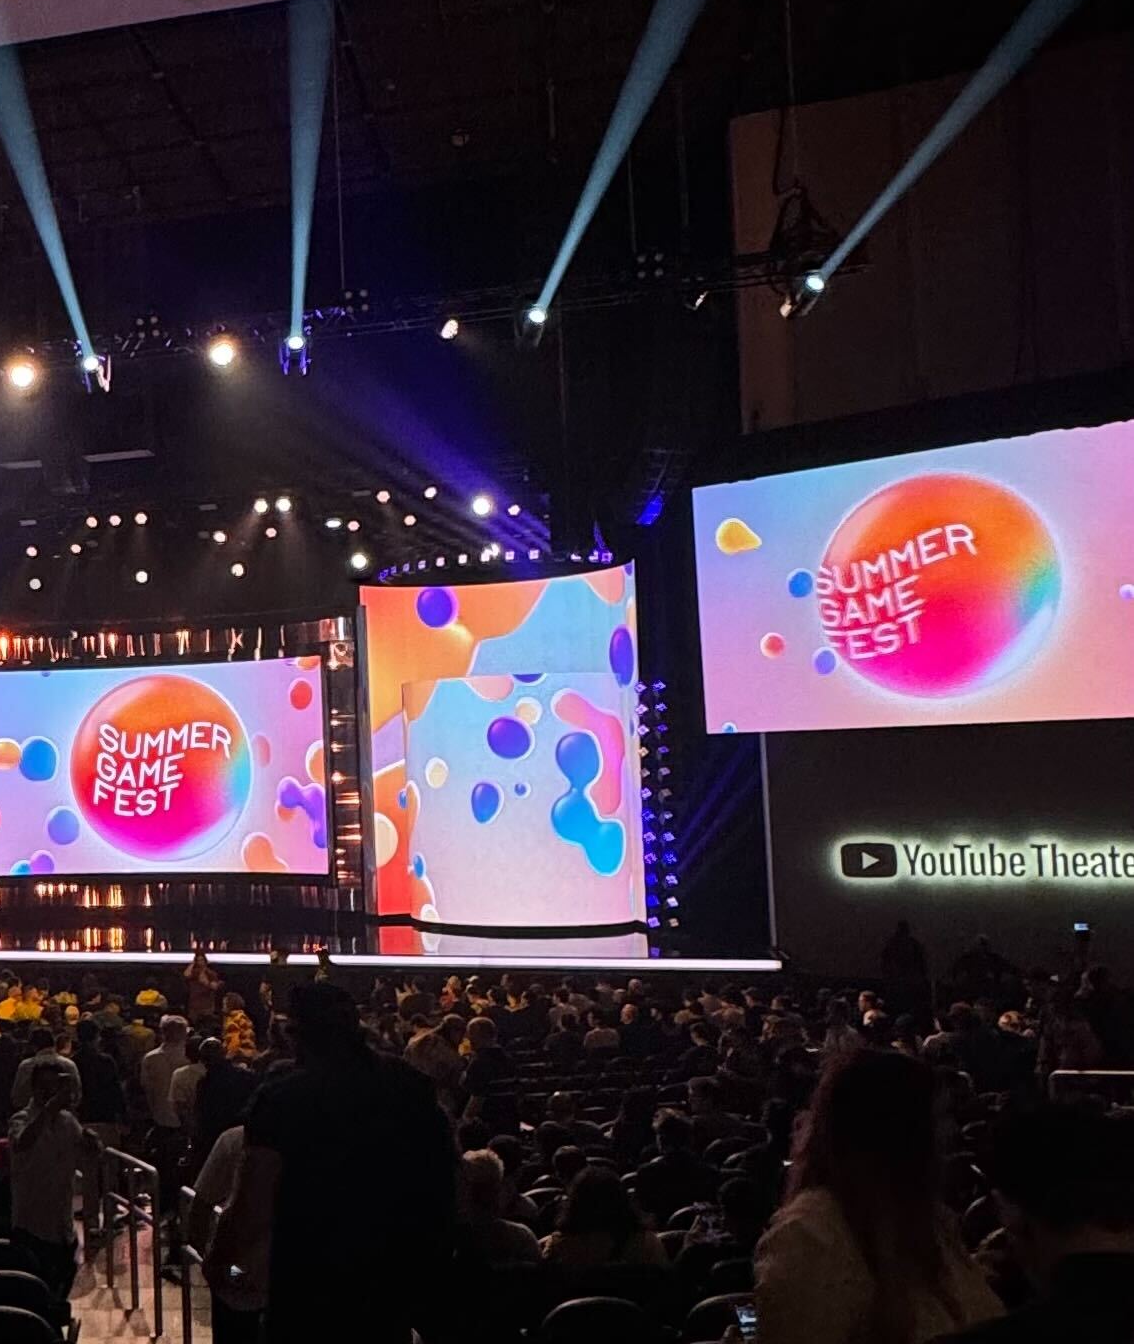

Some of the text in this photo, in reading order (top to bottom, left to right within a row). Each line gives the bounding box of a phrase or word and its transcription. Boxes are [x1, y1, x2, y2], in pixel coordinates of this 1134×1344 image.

[816, 523, 978, 597] SUMMER
[817, 574, 925, 628] GAME
[823, 609, 925, 660] FEST
[98, 721, 232, 760] SUMMER
[96, 752, 186, 788] GAME
[93, 778, 180, 817] FEST
[902, 843, 1026, 878] YouTube
